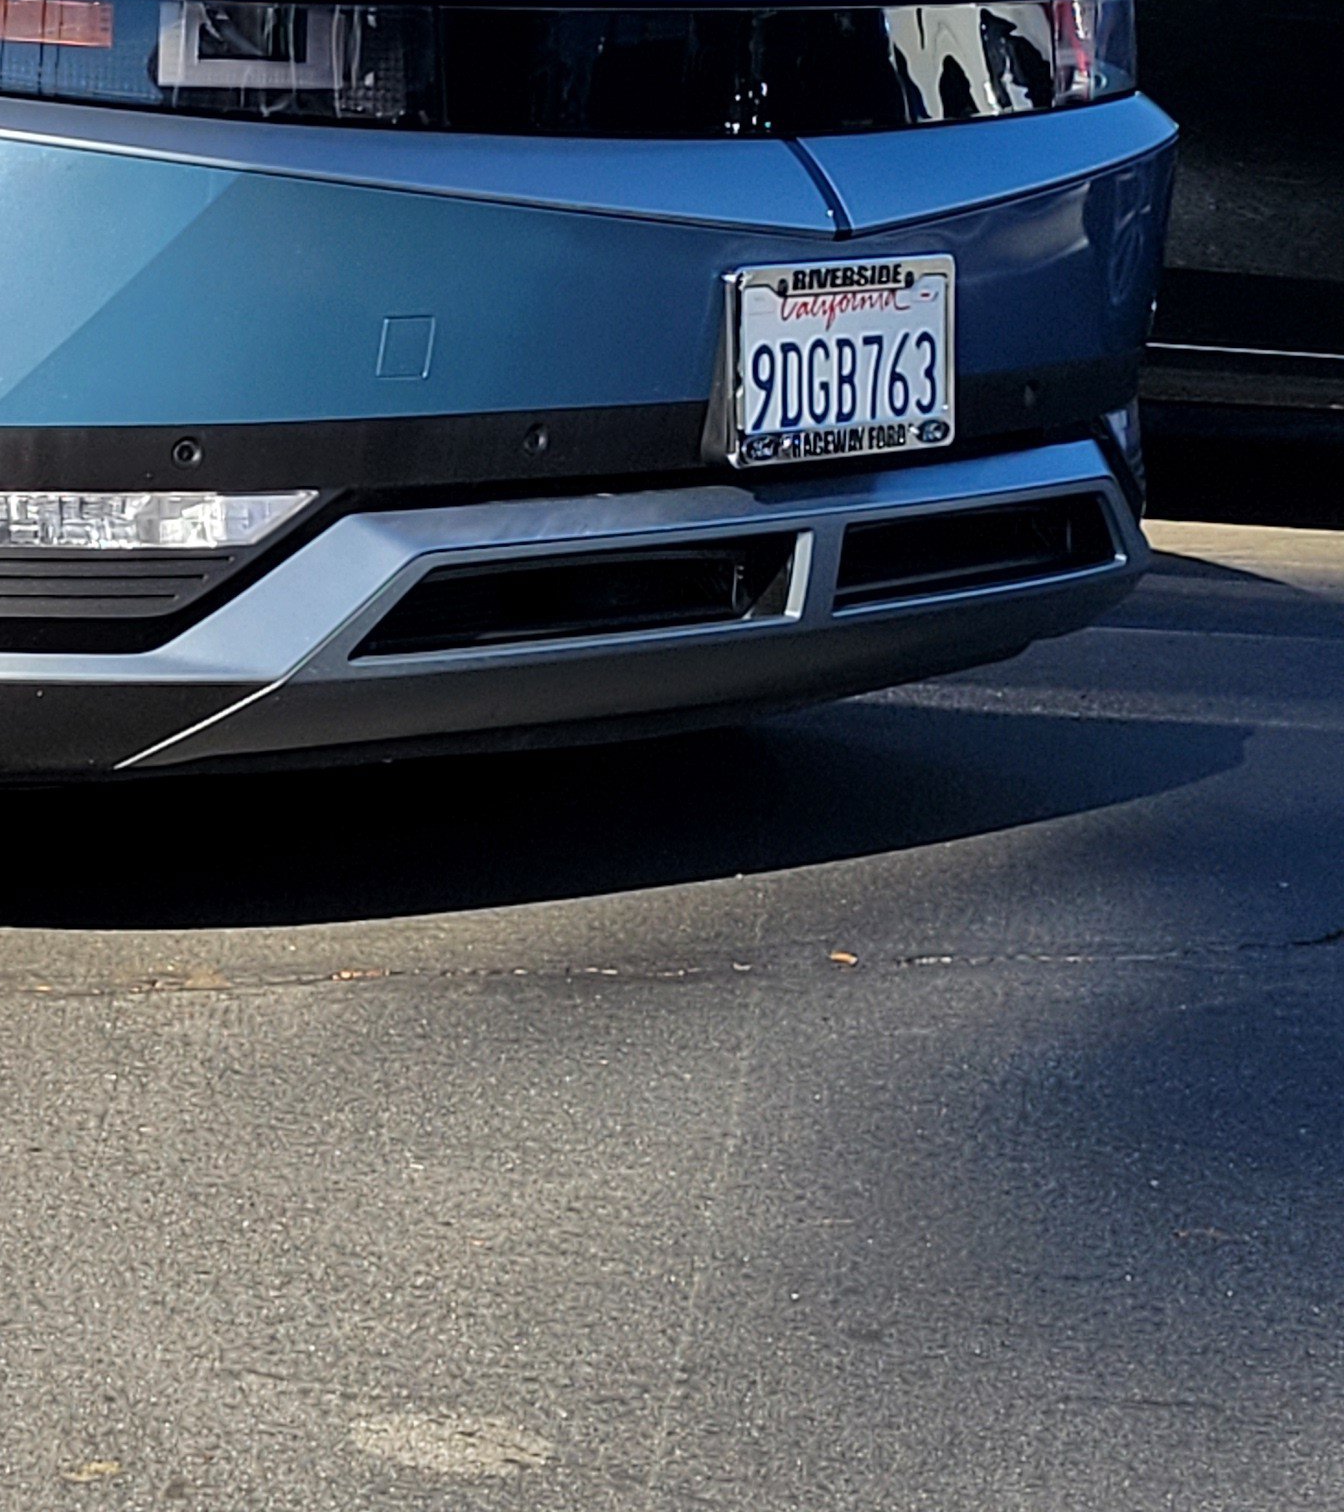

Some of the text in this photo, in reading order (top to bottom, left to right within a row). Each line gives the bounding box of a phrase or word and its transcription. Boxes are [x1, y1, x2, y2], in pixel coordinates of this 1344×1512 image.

[791, 263, 904, 292] RIVERSIDE
[751, 330, 937, 431] 9DGB763
[792, 427, 865, 459] RACEWAY
[868, 423, 907, 451] FORD
